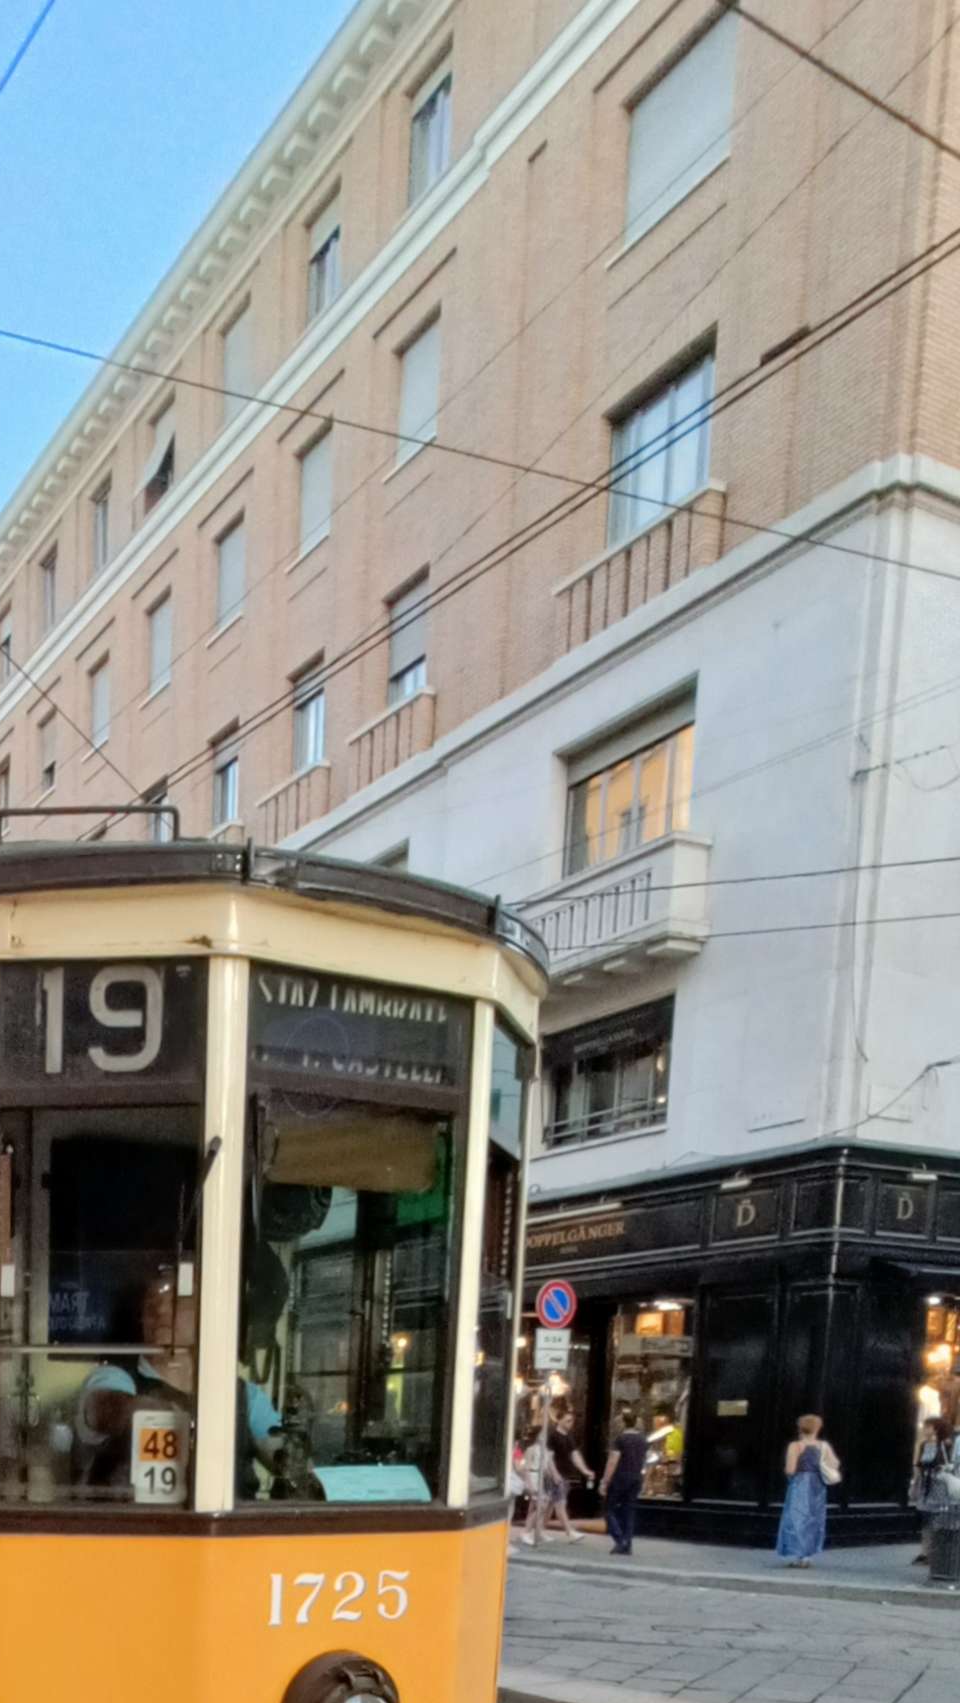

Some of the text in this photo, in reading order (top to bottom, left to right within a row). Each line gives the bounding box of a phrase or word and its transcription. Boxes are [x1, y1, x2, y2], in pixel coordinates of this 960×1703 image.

[43, 965, 164, 1074] 19
[143, 1430, 177, 1459] 48
[143, 1465, 176, 1496] 19
[268, 1570, 411, 1626] 1725
